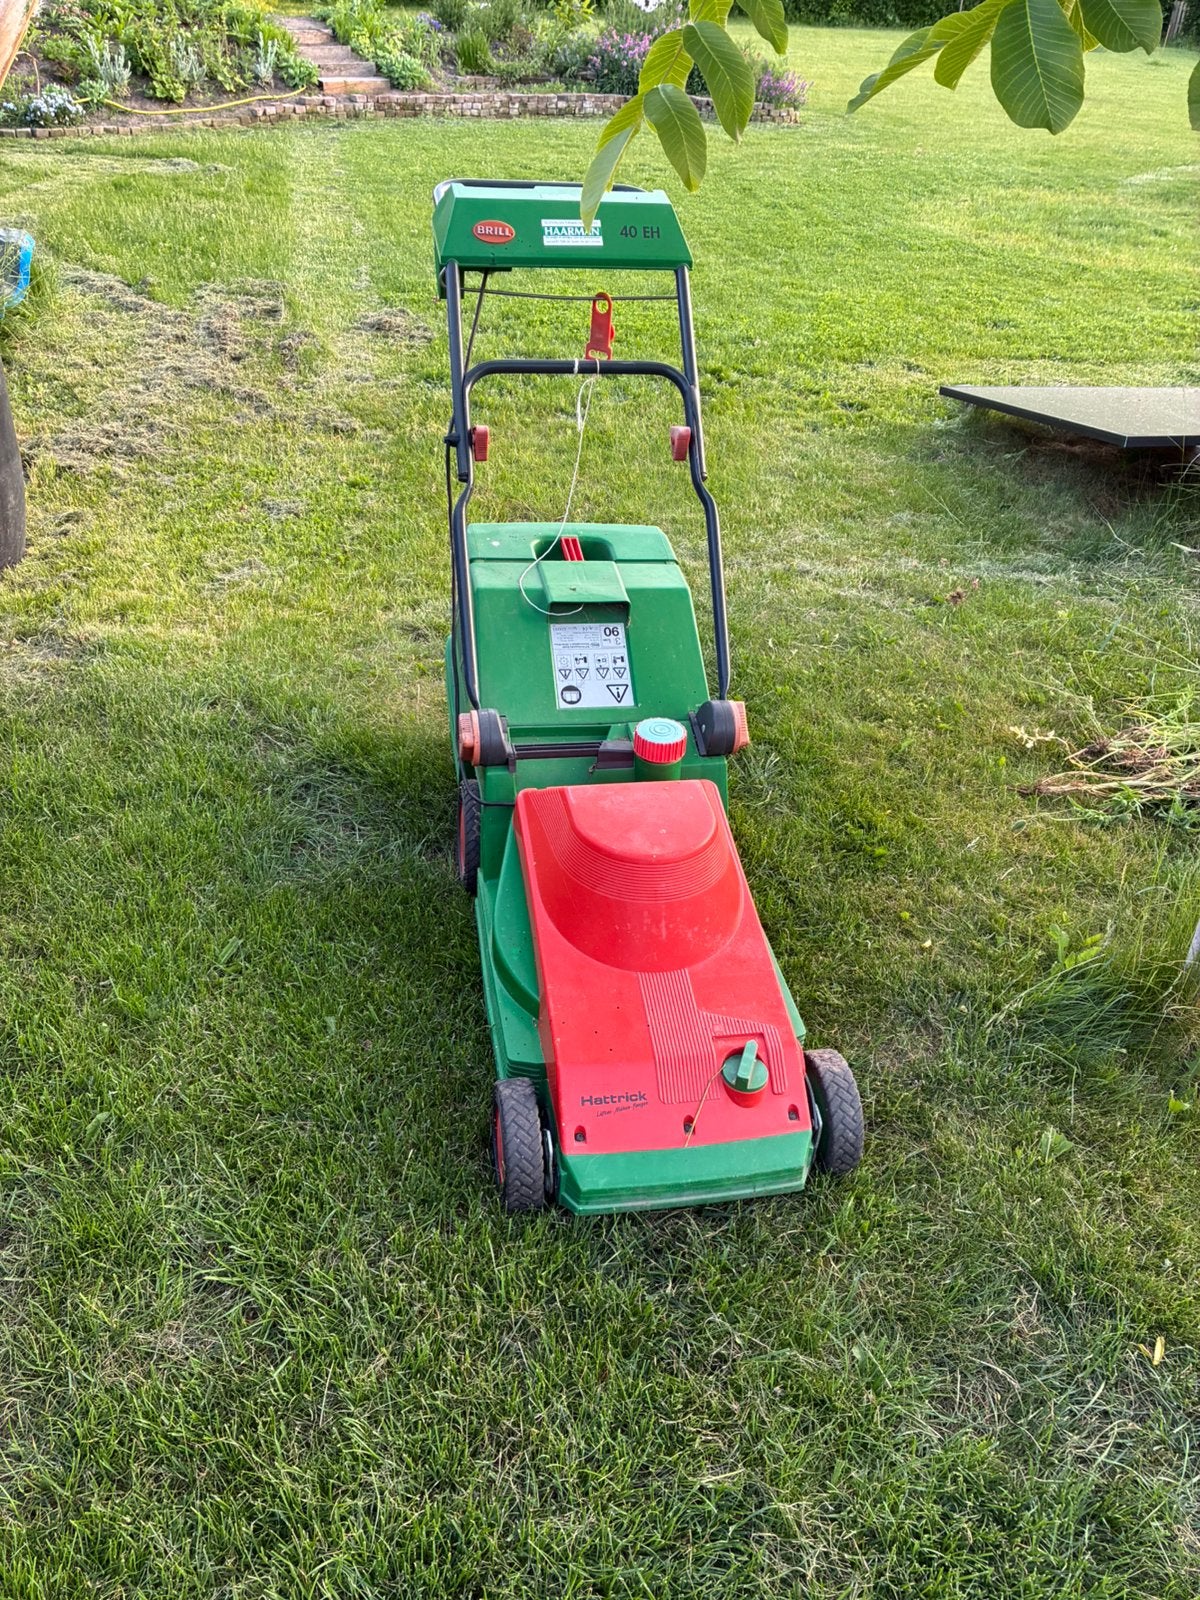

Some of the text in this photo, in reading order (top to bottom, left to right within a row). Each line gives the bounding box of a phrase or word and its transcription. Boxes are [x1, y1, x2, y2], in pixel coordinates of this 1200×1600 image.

[476, 225, 513, 237] BRILL
[620, 225, 660, 239] 40 EH
[580, 1091, 647, 1106] Hattrick
